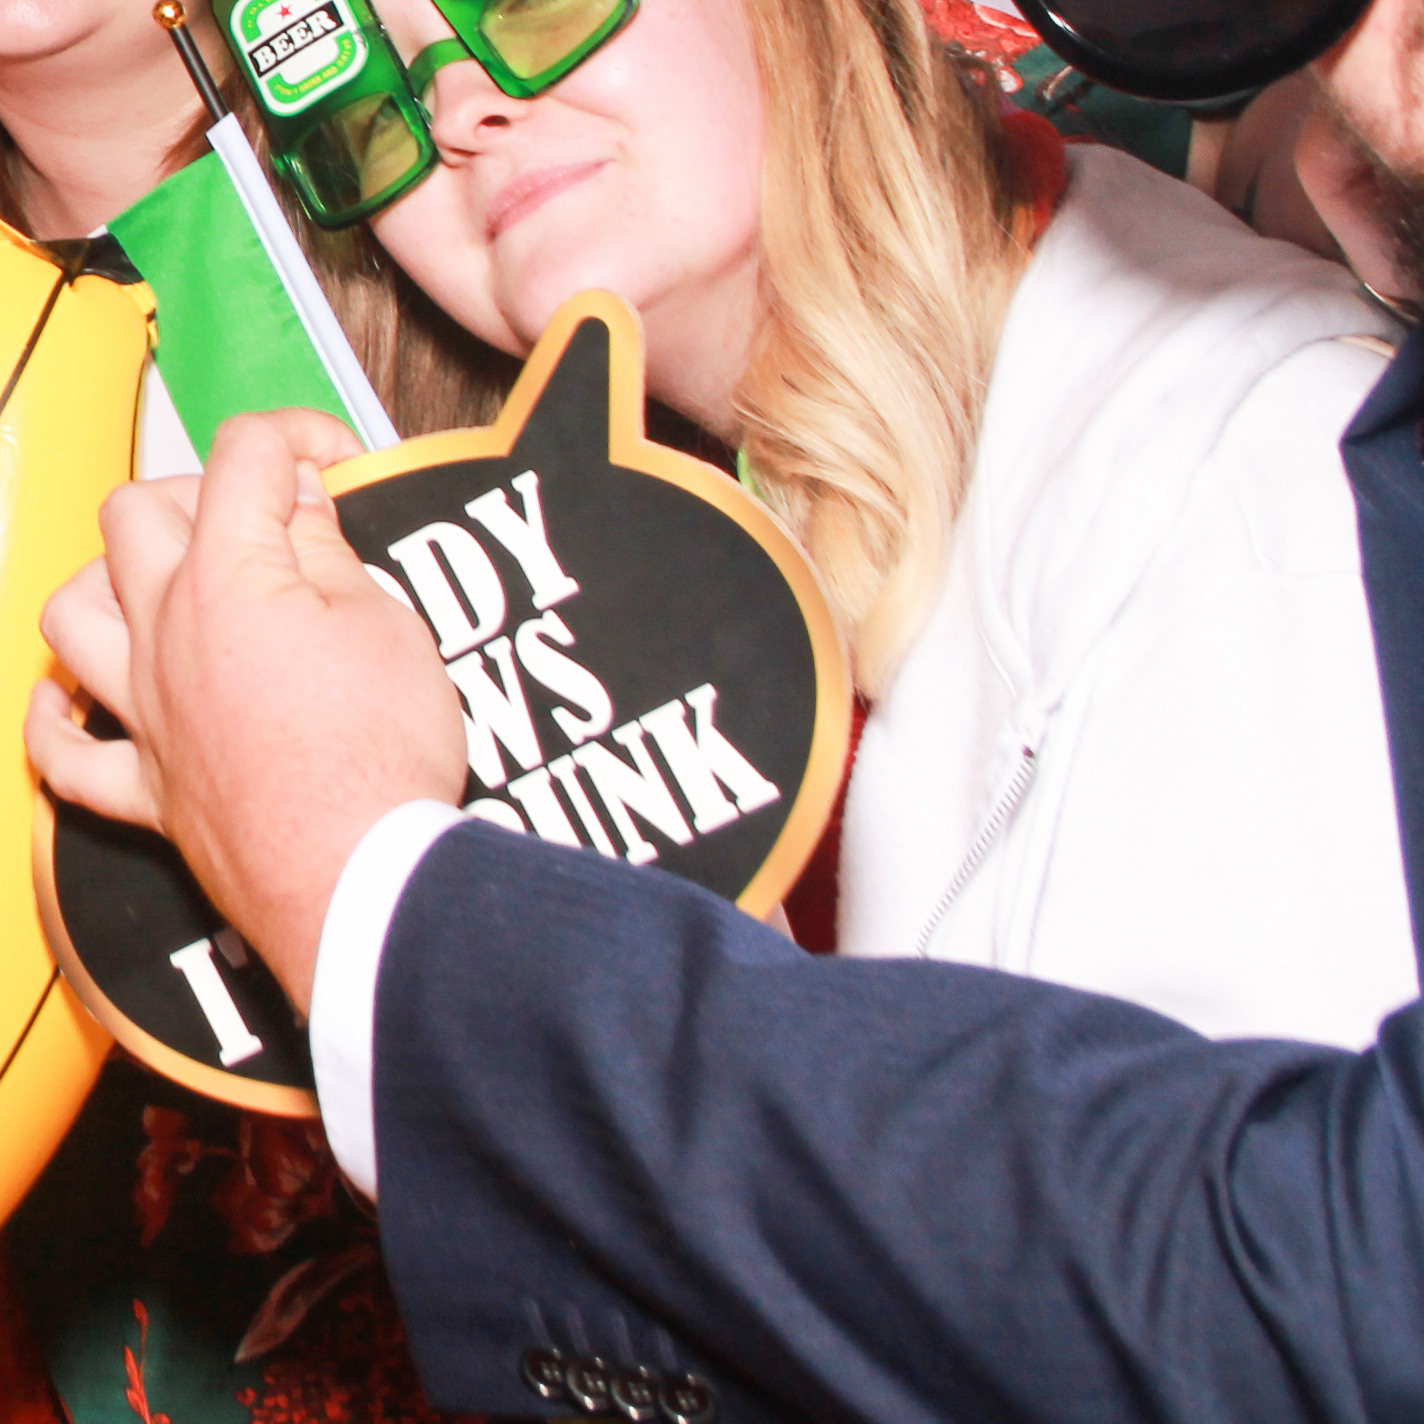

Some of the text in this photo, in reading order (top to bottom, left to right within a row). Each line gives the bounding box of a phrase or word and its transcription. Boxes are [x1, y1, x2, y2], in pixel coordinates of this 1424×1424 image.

[252, 10, 337, 73] BEER
[362, 468, 581, 660] DY
[467, 682, 782, 867] UNK
